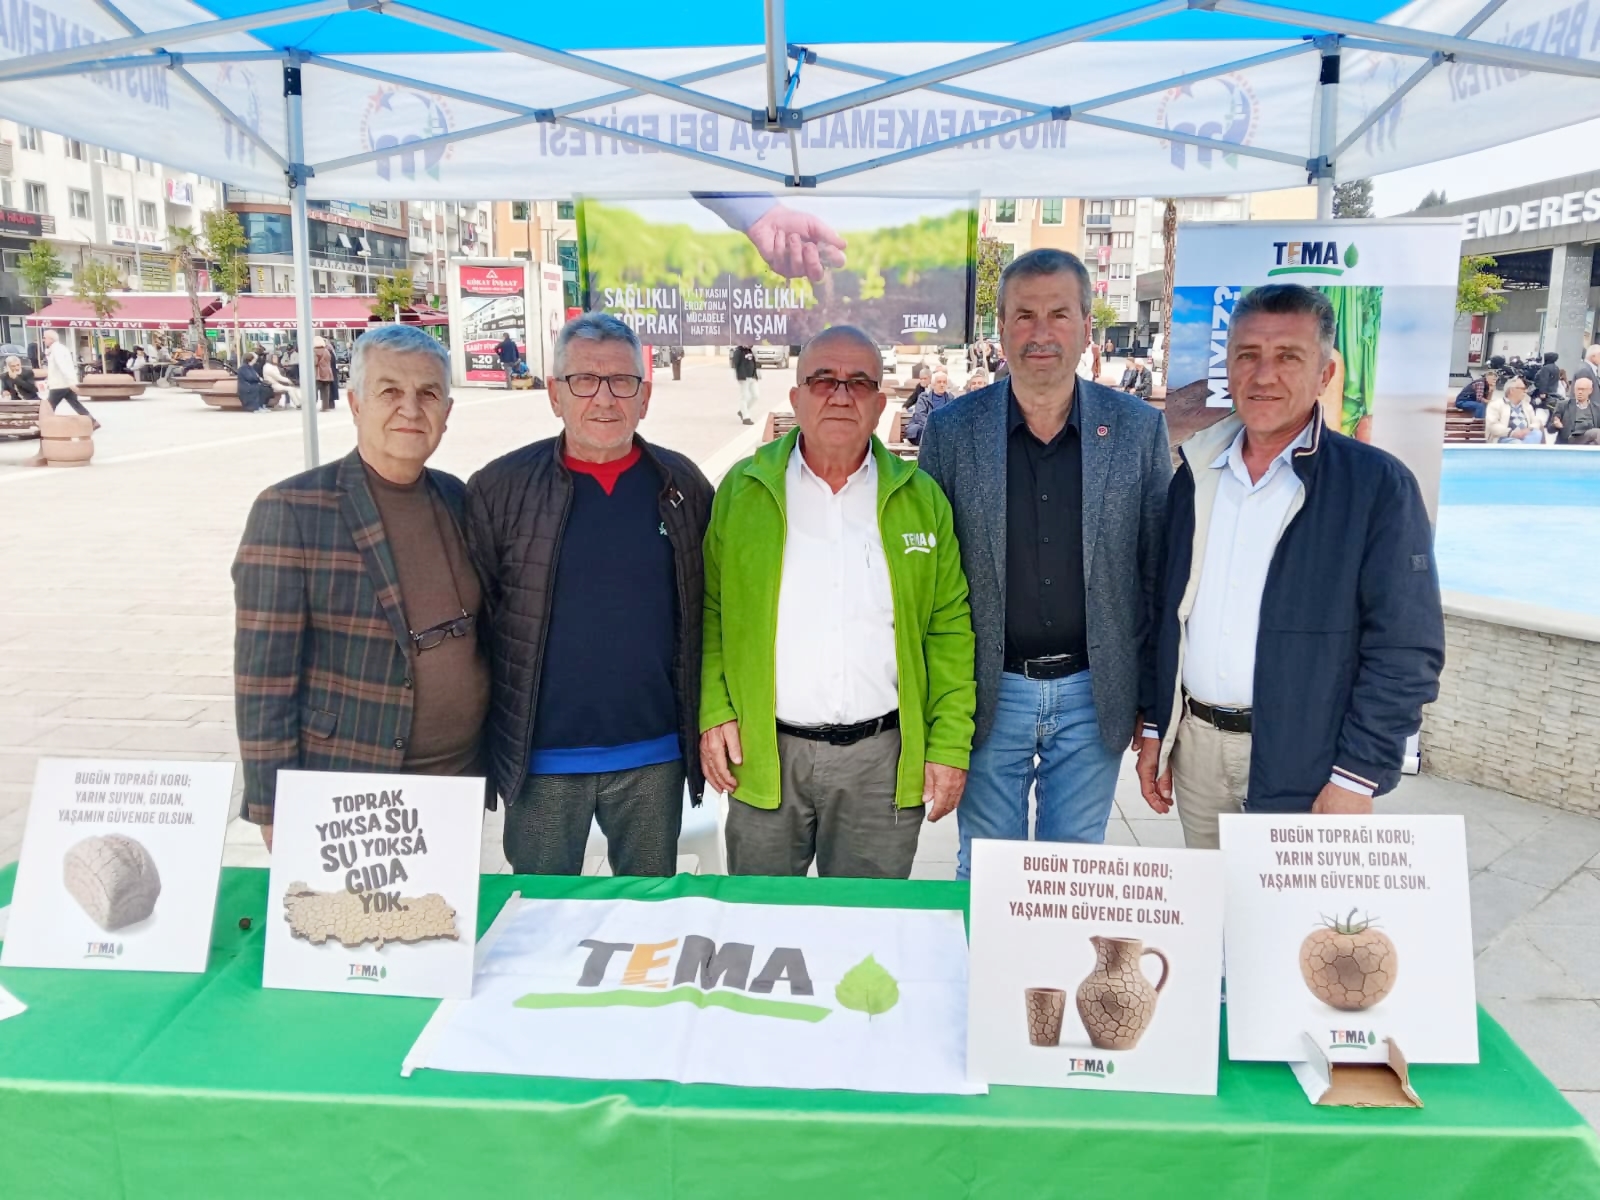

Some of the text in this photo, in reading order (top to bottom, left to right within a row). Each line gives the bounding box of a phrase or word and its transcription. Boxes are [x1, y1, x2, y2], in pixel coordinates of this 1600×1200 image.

[1273, 241, 1339, 265] TEMA
[604, 283, 677, 309] SAĞLIKLI
[705, 287, 728, 299] KASIM
[733, 283, 805, 309] SAĞLIKLI
[684, 302, 727, 311] EROZYONLA
[686, 311, 725, 323] MÜCADELE
[902, 313, 937, 328] TEMA
[690, 324, 721, 336] HAFTASI
[733, 314, 787, 341] YAŞAM
[901, 532, 928, 547] TEMA
[74, 769, 192, 788] BUGÜN TOPRAĞI KORU;
[75, 791, 184, 807] YARIN SUYUN, GIDAN,
[331, 789, 405, 814] TOPRAK
[58, 809, 195, 826] YAŞAMIN GÜVENDE OLSUN.
[315, 812, 383, 842] YOKSA
[1270, 826, 1415, 846] BUGÜN TOPRAĞI KORU;
[320, 834, 428, 873] SU YOKSA
[1275, 851, 1412, 868] YARIN SUYUN, GIDAN,
[345, 857, 408, 895] GIDA
[1023, 854, 1173, 880] BUGÜN TOPRAĞI KORU;
[1027, 879, 1167, 902] YARIN SUYUN, GIDAN,
[1259, 871, 1431, 892] YAŞAMIN GÜVENDE OLSUN.
[358, 891, 410, 914] YOK.
[1009, 901, 1184, 925] YAŞAMIN GÜVENDE OLSUN.
[87, 942, 115, 954] TEMA
[349, 963, 378, 977] TEMA
[575, 933, 815, 997] TEMA
[1330, 1030, 1366, 1044] TEMA
[1069, 1058, 1104, 1073] TEMA
